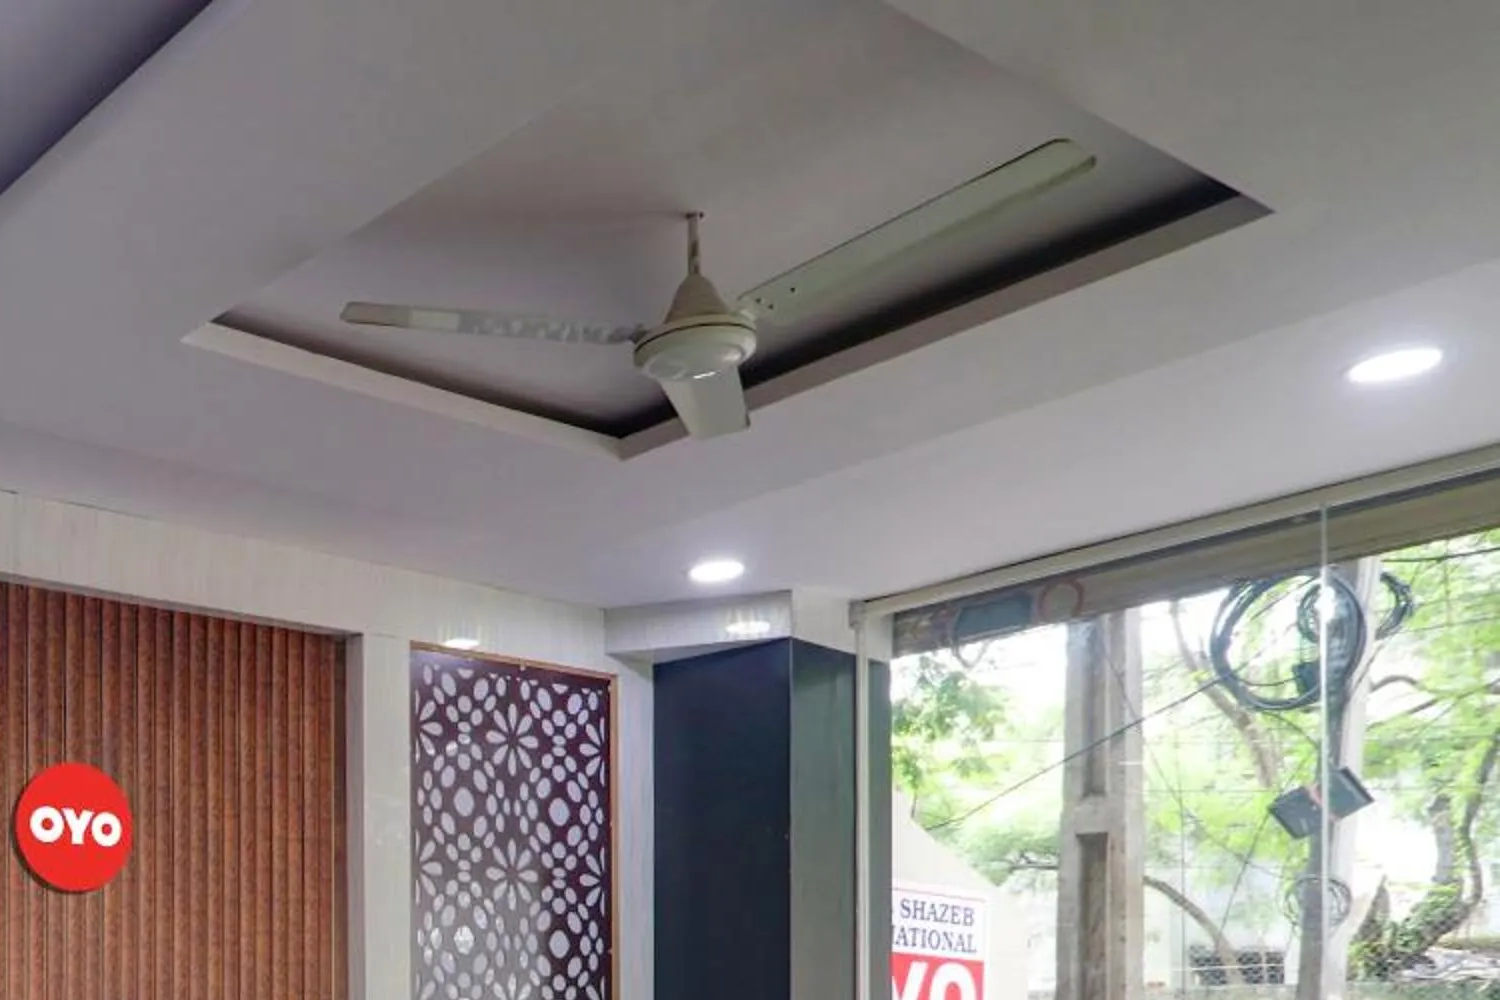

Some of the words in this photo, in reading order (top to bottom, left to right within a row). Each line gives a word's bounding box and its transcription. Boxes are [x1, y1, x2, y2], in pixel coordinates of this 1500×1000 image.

[29, 805, 122, 847] OYO
[900, 898, 975, 927] SHAZEB
[891, 925, 977, 953] ATIONAL
